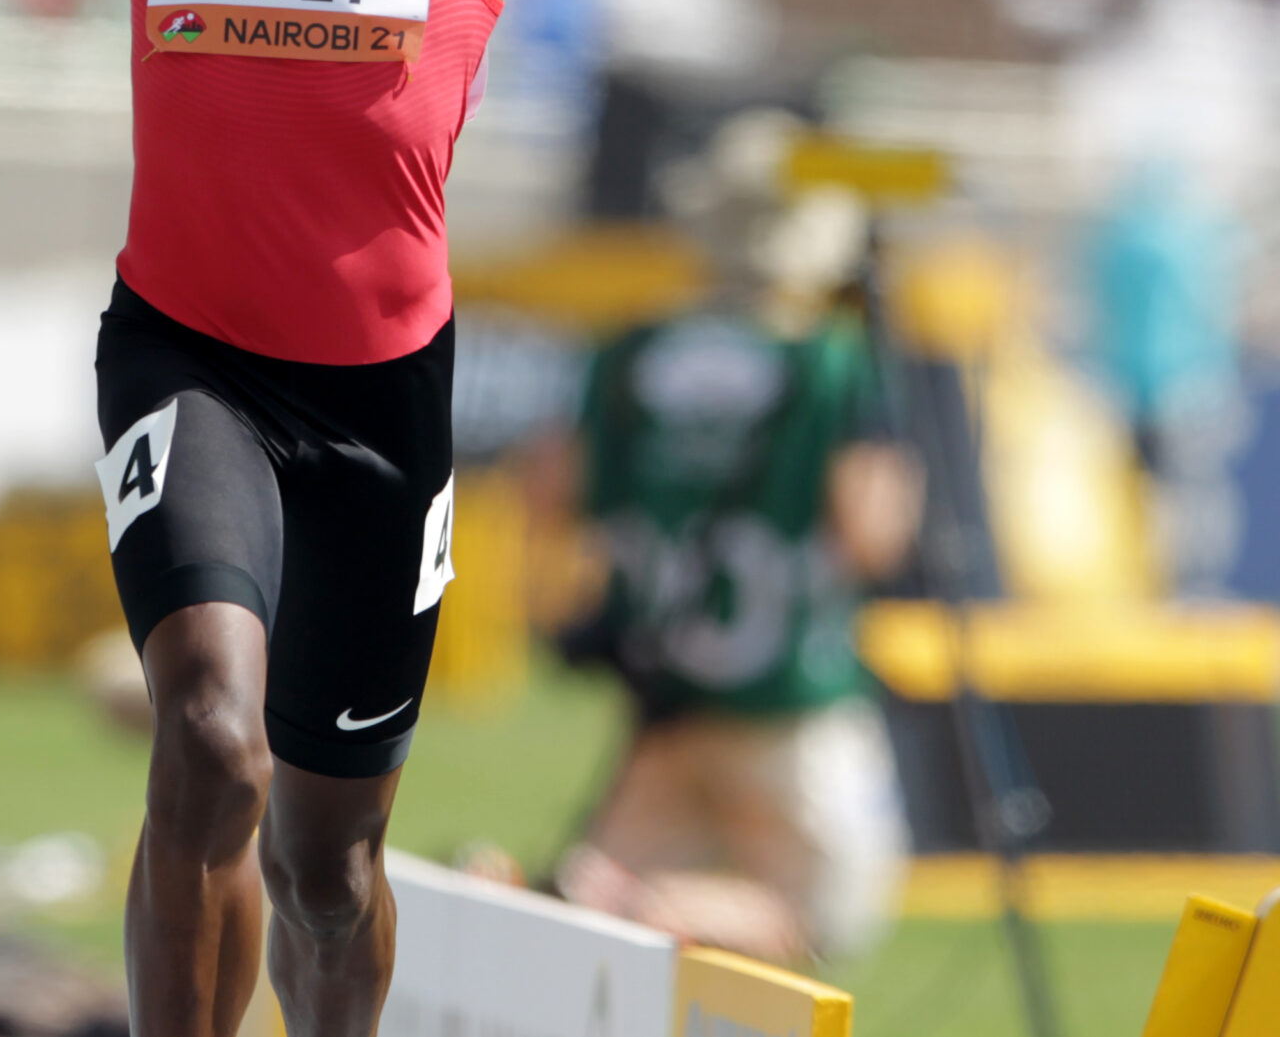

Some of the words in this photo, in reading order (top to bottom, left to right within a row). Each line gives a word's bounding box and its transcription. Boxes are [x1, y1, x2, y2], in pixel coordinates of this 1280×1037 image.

[224, 18, 359, 50] NAIROBI
[370, 26, 406, 51] 21
[118, 432, 159, 505] 4
[434, 500, 451, 578] 4
